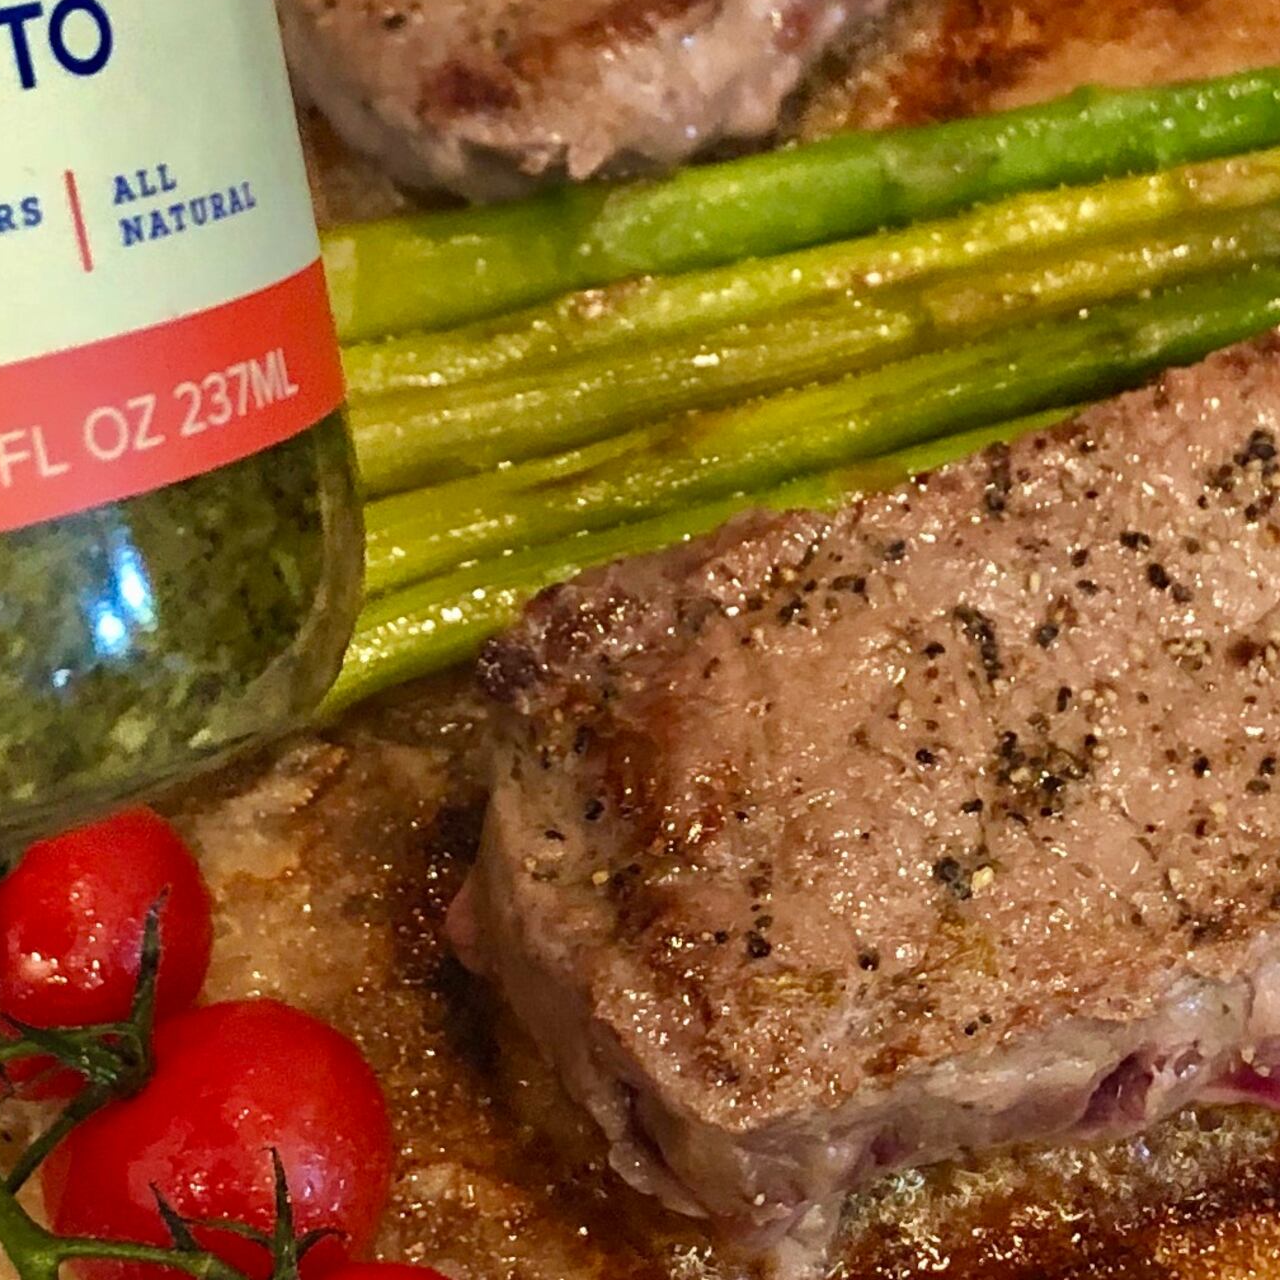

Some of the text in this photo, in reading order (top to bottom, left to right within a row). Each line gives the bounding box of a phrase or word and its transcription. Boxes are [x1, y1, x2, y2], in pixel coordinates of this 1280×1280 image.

[112, 164, 176, 205] ALL
[119, 182, 257, 248] NATURAL
[83, 393, 165, 460] OZ
[175, 348, 300, 436] 237ML
